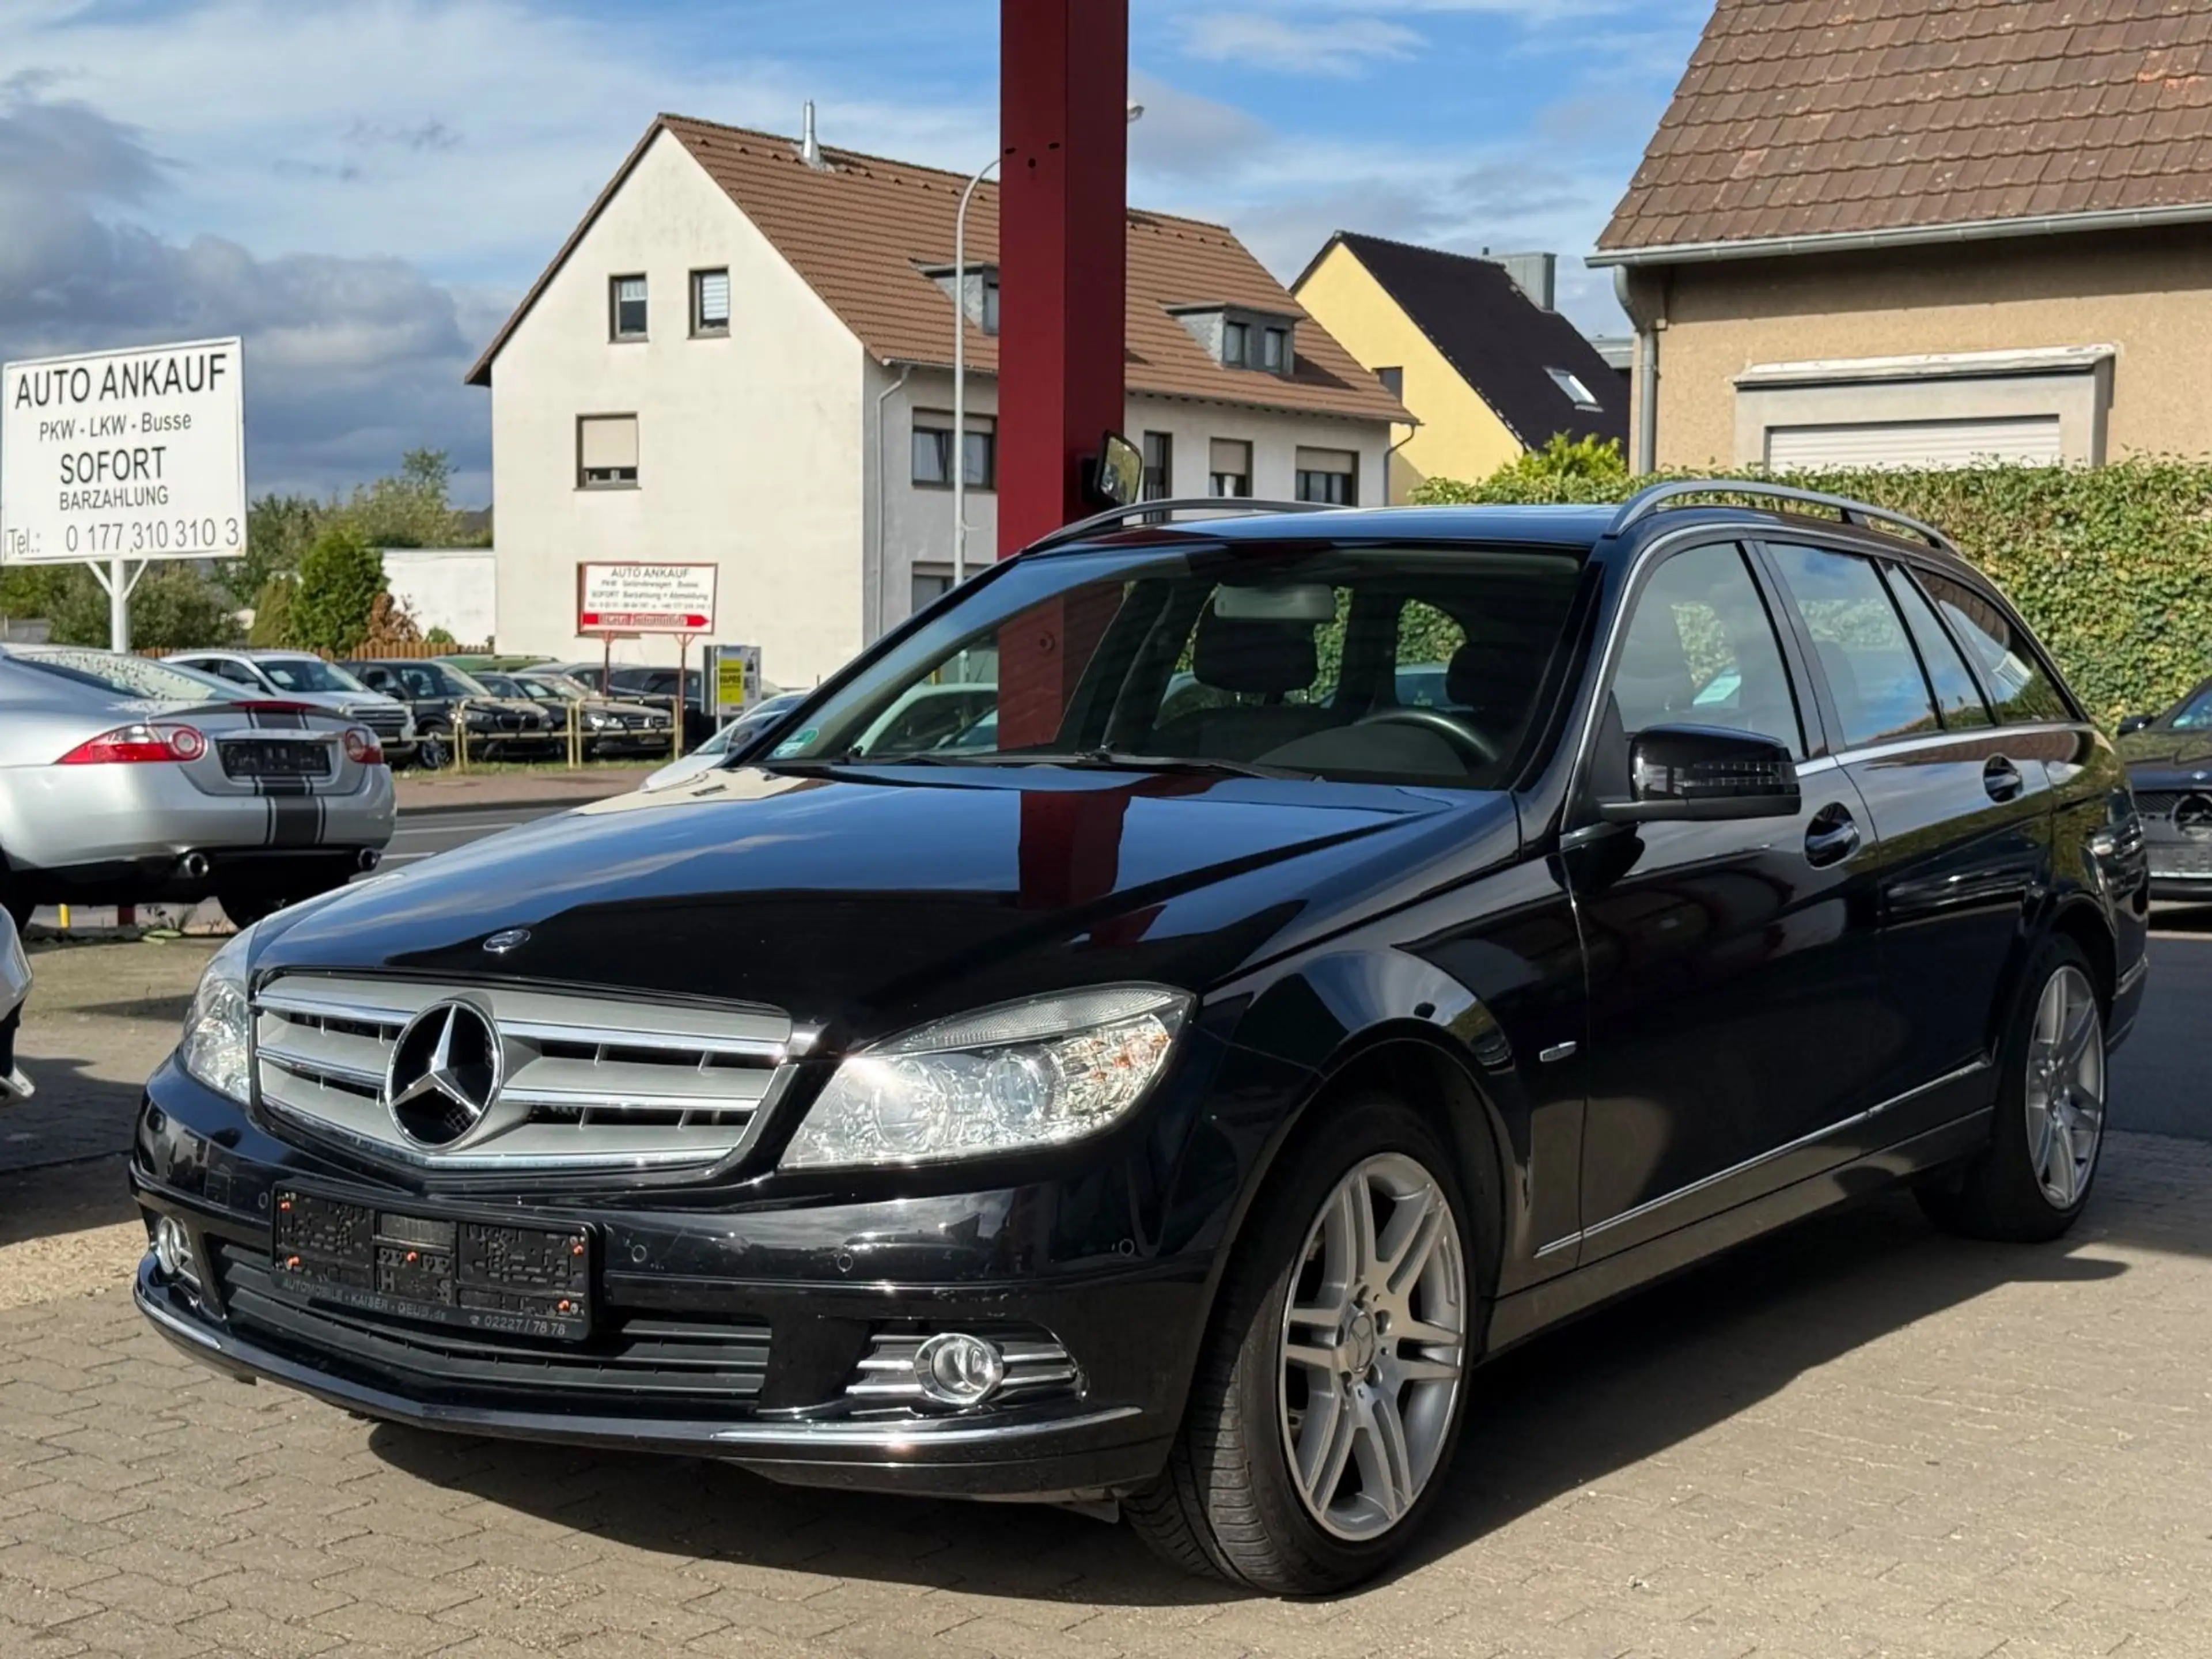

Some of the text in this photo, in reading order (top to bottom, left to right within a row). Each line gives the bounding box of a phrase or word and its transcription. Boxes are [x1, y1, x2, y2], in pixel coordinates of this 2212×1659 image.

[15, 354, 227, 410] AUTO ANKAUF
[40, 419, 75, 441] PKW
[90, 415, 127, 437] LKW
[142, 412, 192, 433] Busse
[60, 446, 166, 485] SOFORT
[60, 483, 168, 511] BARZAHLUNG
[7, 528, 40, 555] Tel.:
[611, 567, 641, 578] AUTO
